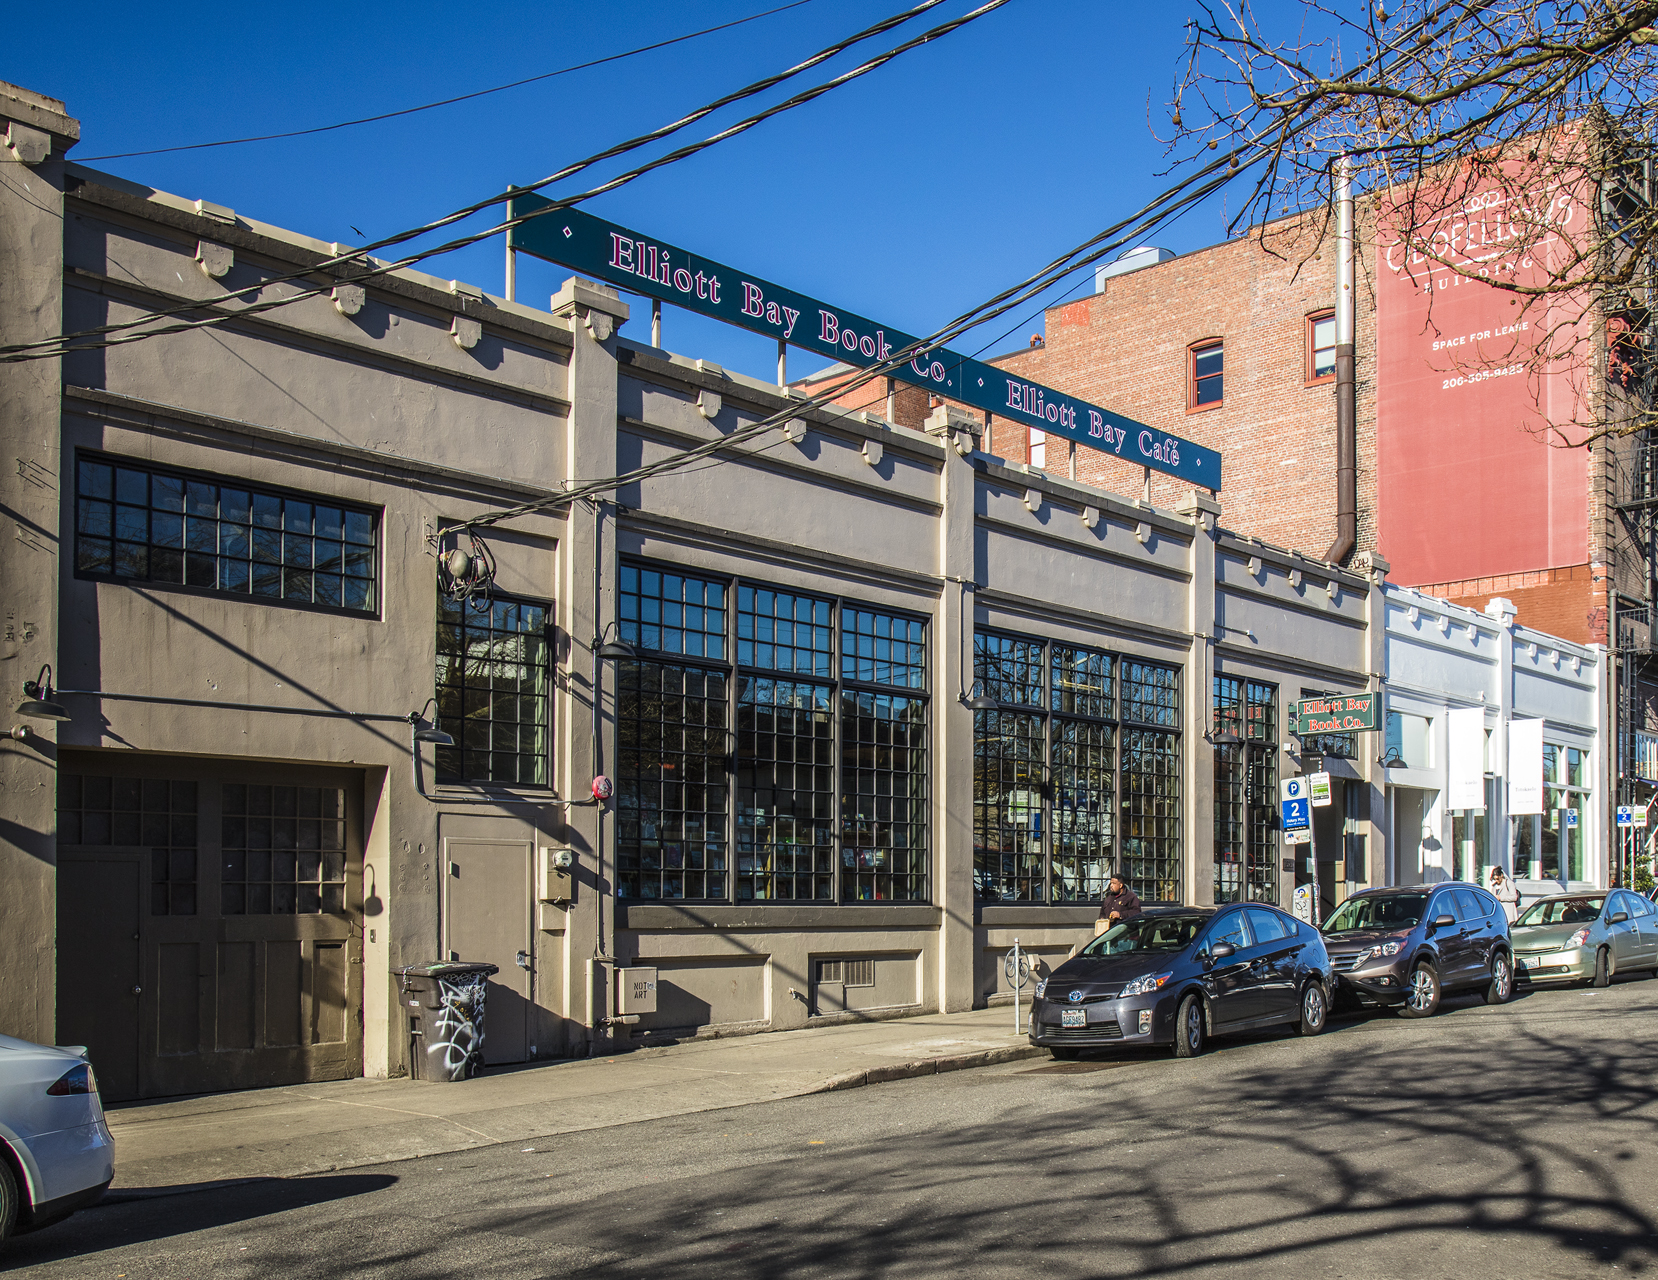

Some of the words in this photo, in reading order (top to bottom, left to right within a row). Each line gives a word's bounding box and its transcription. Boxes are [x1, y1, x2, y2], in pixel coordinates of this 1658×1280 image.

[609, 231, 722, 305] Elliott
[740, 281, 801, 339] Bay
[818, 309, 893, 364] Book
[910, 346, 953, 387] Co.
[1432, 336, 1466, 351] SPACE
[1470, 330, 1491, 343] FOR
[1495, 322, 1529, 337] LEASE
[1005, 379, 1076, 430] Elliott
[1088, 409, 1126, 454] Bay
[1138, 430, 1180, 467] Café
[1302, 699, 1343, 715] Elliott
[1346, 698, 1371, 712] Bay
[1308, 717, 1341, 731] Book
[1343, 715, 1365, 728] Co.
[1291, 802, 1300, 817] 2
[633, 982, 648, 991] NOT
[634, 991, 648, 999] ART
